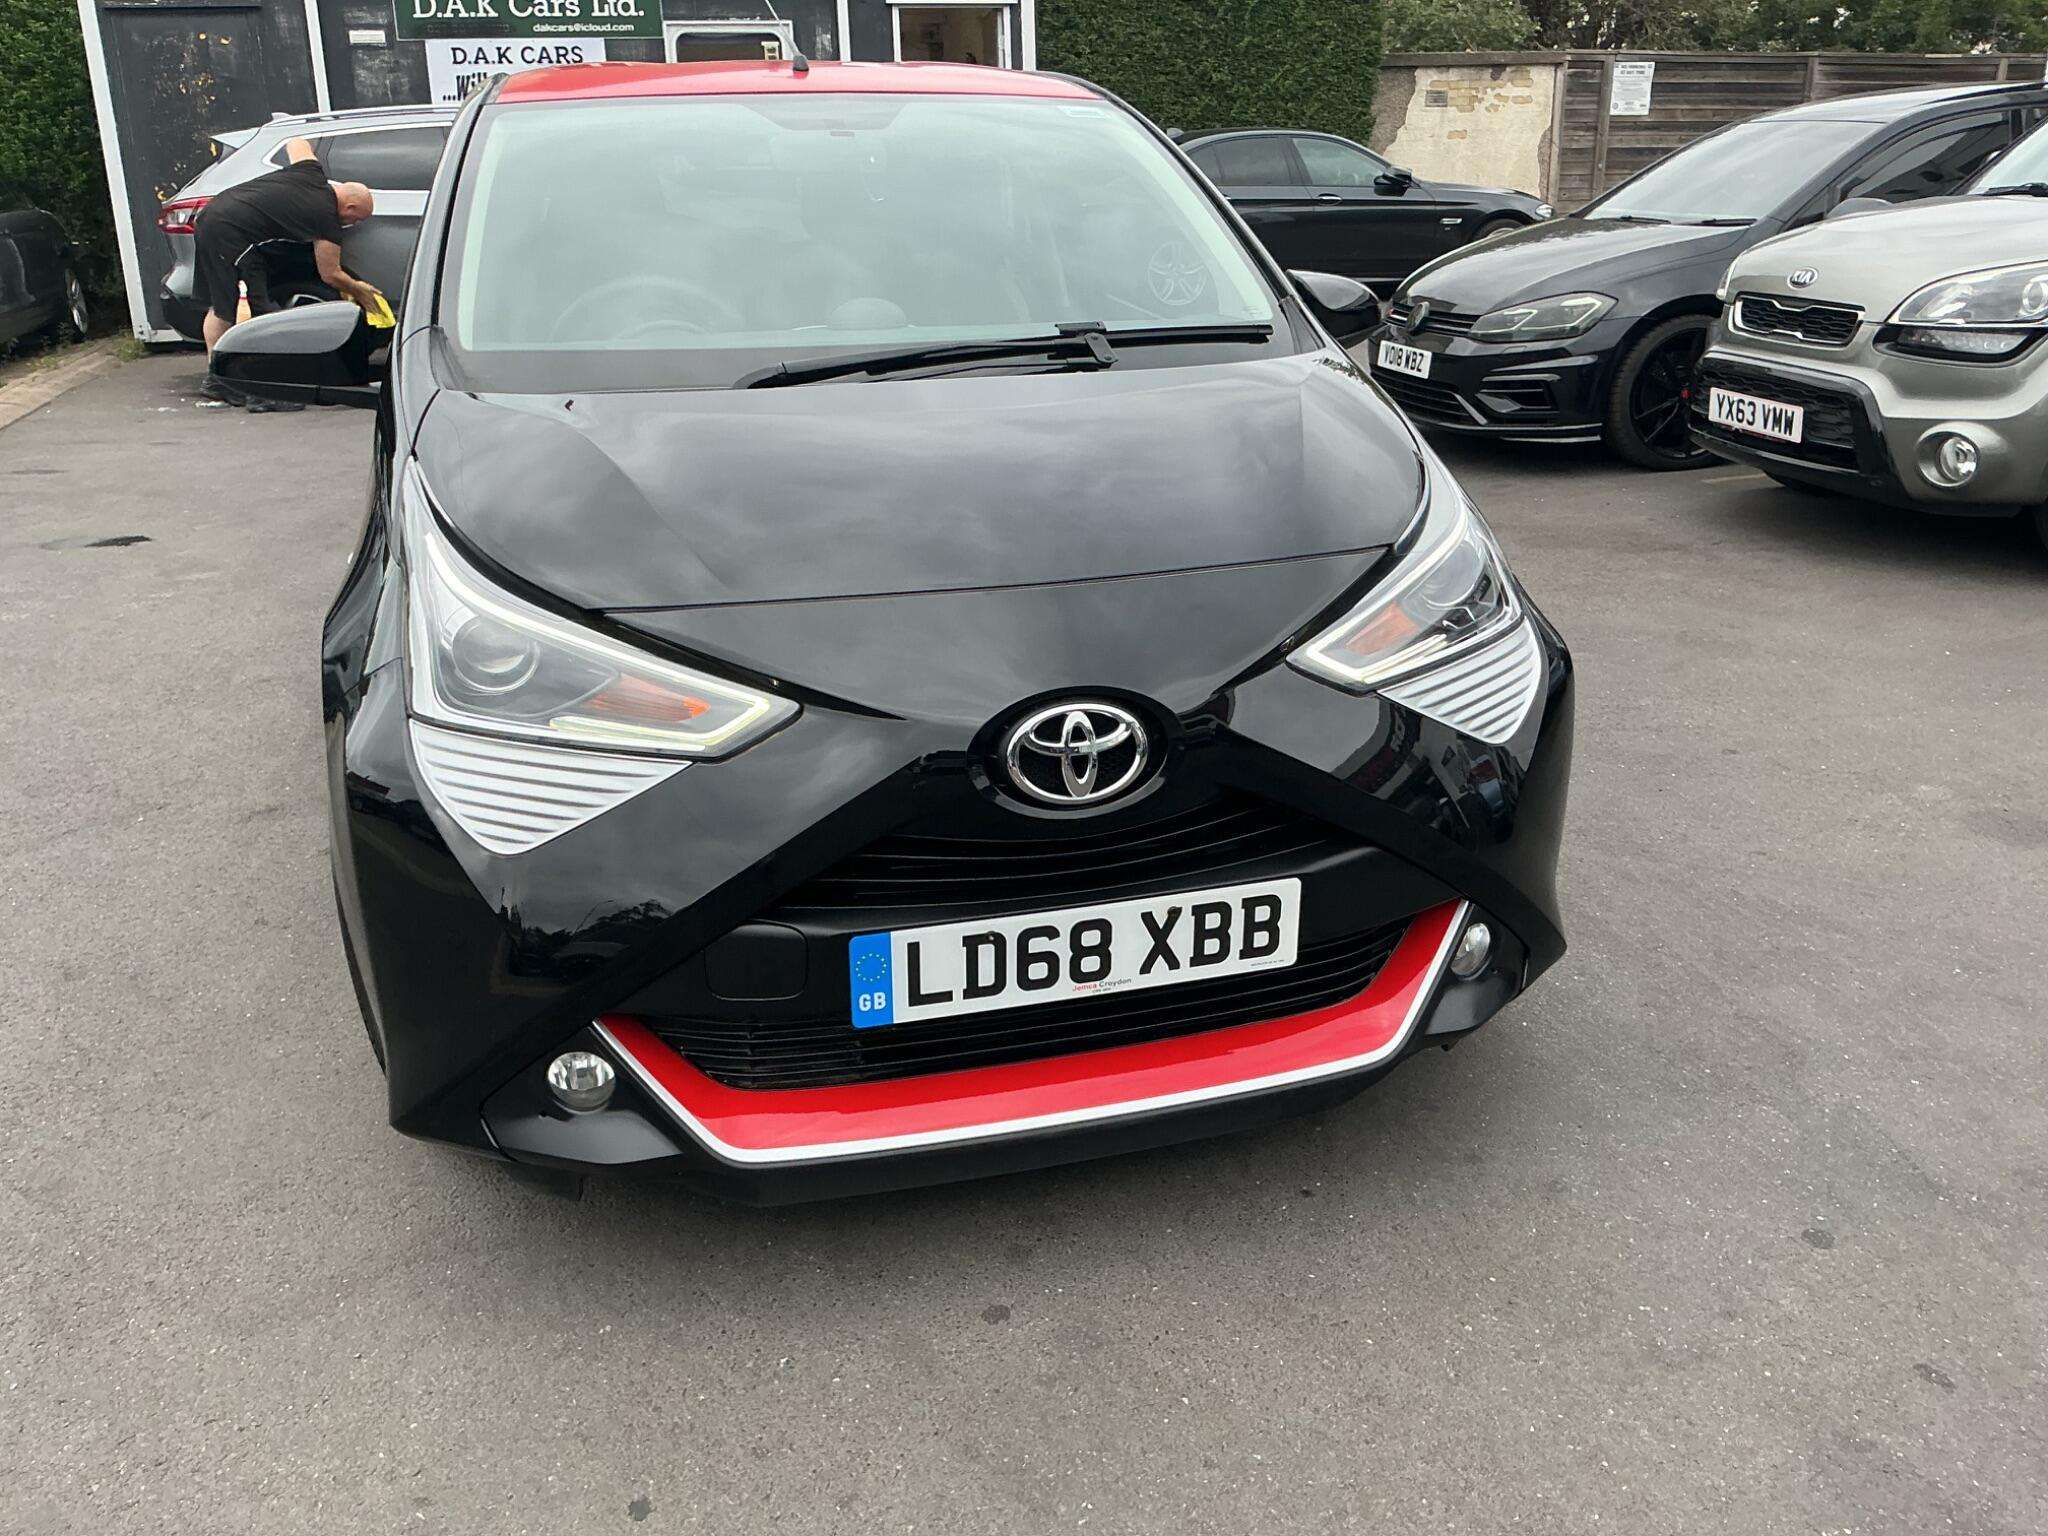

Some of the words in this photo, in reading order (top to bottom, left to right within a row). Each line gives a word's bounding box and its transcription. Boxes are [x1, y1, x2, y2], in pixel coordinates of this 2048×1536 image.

[413, 0, 499, 18] D.A.K
[509, 0, 581, 18] Cars
[591, 0, 645, 17] Ltd.
[532, 22, 635, 32] dakcars@icloud.com
[451, 46, 514, 65] D.A.K
[520, 45, 584, 65] CARS
[1790, 269, 1814, 284] KIA
[1716, 393, 1756, 426] YX63
[1762, 403, 1795, 437] VMW
[906, 917, 1113, 1008] LD68
[1138, 893, 1283, 975] XBB
[1098, 978, 1132, 988] Croydon
[858, 991, 887, 1012] GB
